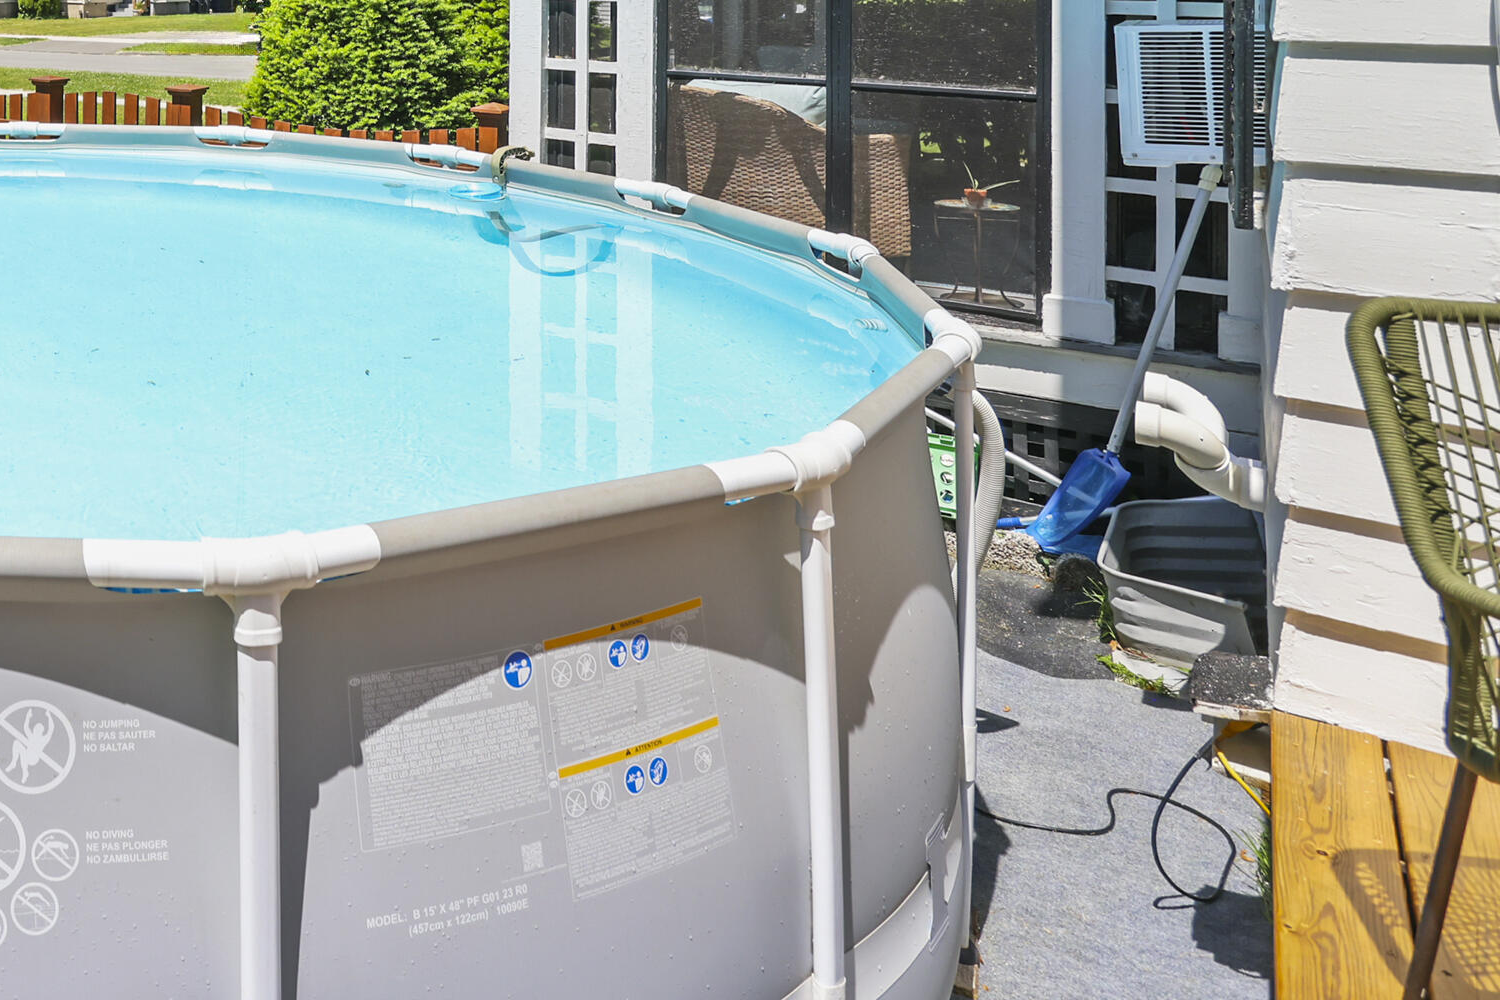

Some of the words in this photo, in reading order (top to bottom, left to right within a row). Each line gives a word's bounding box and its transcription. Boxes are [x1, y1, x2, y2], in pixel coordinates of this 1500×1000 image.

[82, 719, 97, 729] NO
[98, 718, 140, 729] JUMPING
[83, 731, 97, 741] NE
[98, 730, 117, 741] PAS
[118, 729, 156, 740] SAUTER
[83, 743, 97, 753] NO
[99, 742, 136, 752] SALTAR
[85, 830, 100, 840] NO
[102, 828, 135, 840] DIVING
[86, 842, 100, 852] NE
[101, 841, 121, 852] PAS
[122, 839, 168, 851] PLONGER
[86, 855, 101, 865] NO
[102, 851, 170, 864] ZAMBULLIRSE
[366, 912, 408, 929] MODEL:
[412, 909, 421, 921] B
[439, 904, 447, 914] X
[466, 896, 481, 908] PF
[502, 887, 514, 899] 23
[408, 921, 445, 938] (457cm
[455, 910, 490, 926] 122cm)
